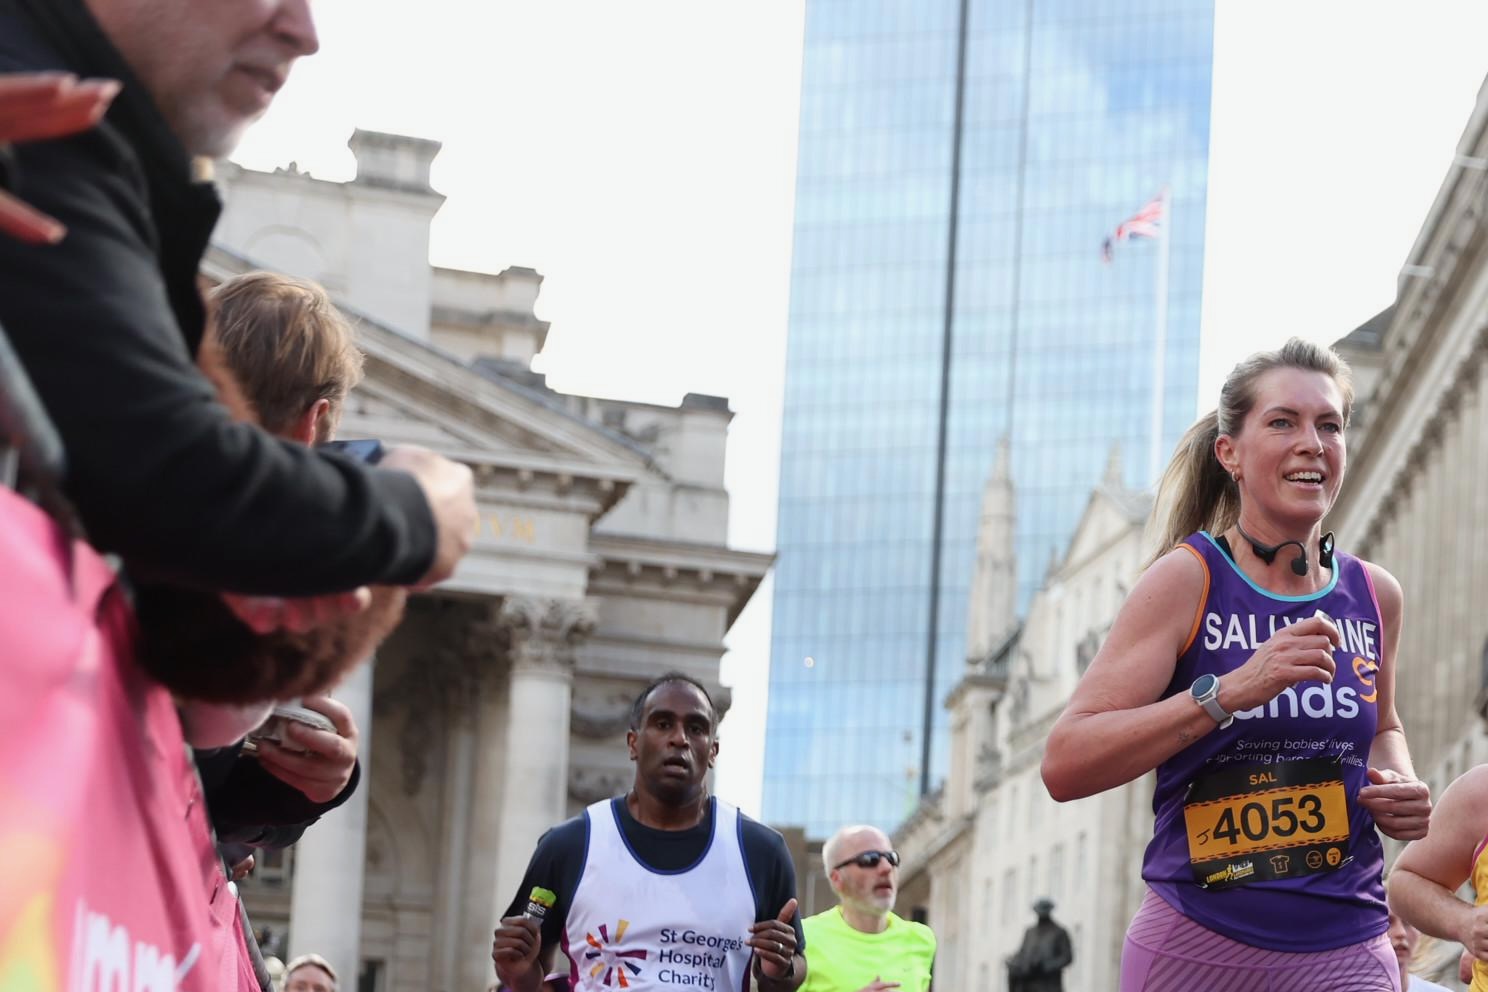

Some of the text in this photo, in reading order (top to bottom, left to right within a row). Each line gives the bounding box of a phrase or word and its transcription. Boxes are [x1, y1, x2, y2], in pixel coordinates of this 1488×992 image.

[1204, 612, 1377, 659] SALNE
[1233, 683, 1359, 719] nds
[1236, 739, 1281, 751] Saving
[1284, 738, 1329, 751] babies'
[1249, 772, 1278, 785] SAL
[1213, 794, 1326, 846] 4053
[660, 928, 744, 952] St George's
[659, 950, 727, 968] Hospital
[658, 970, 715, 990] Charity
